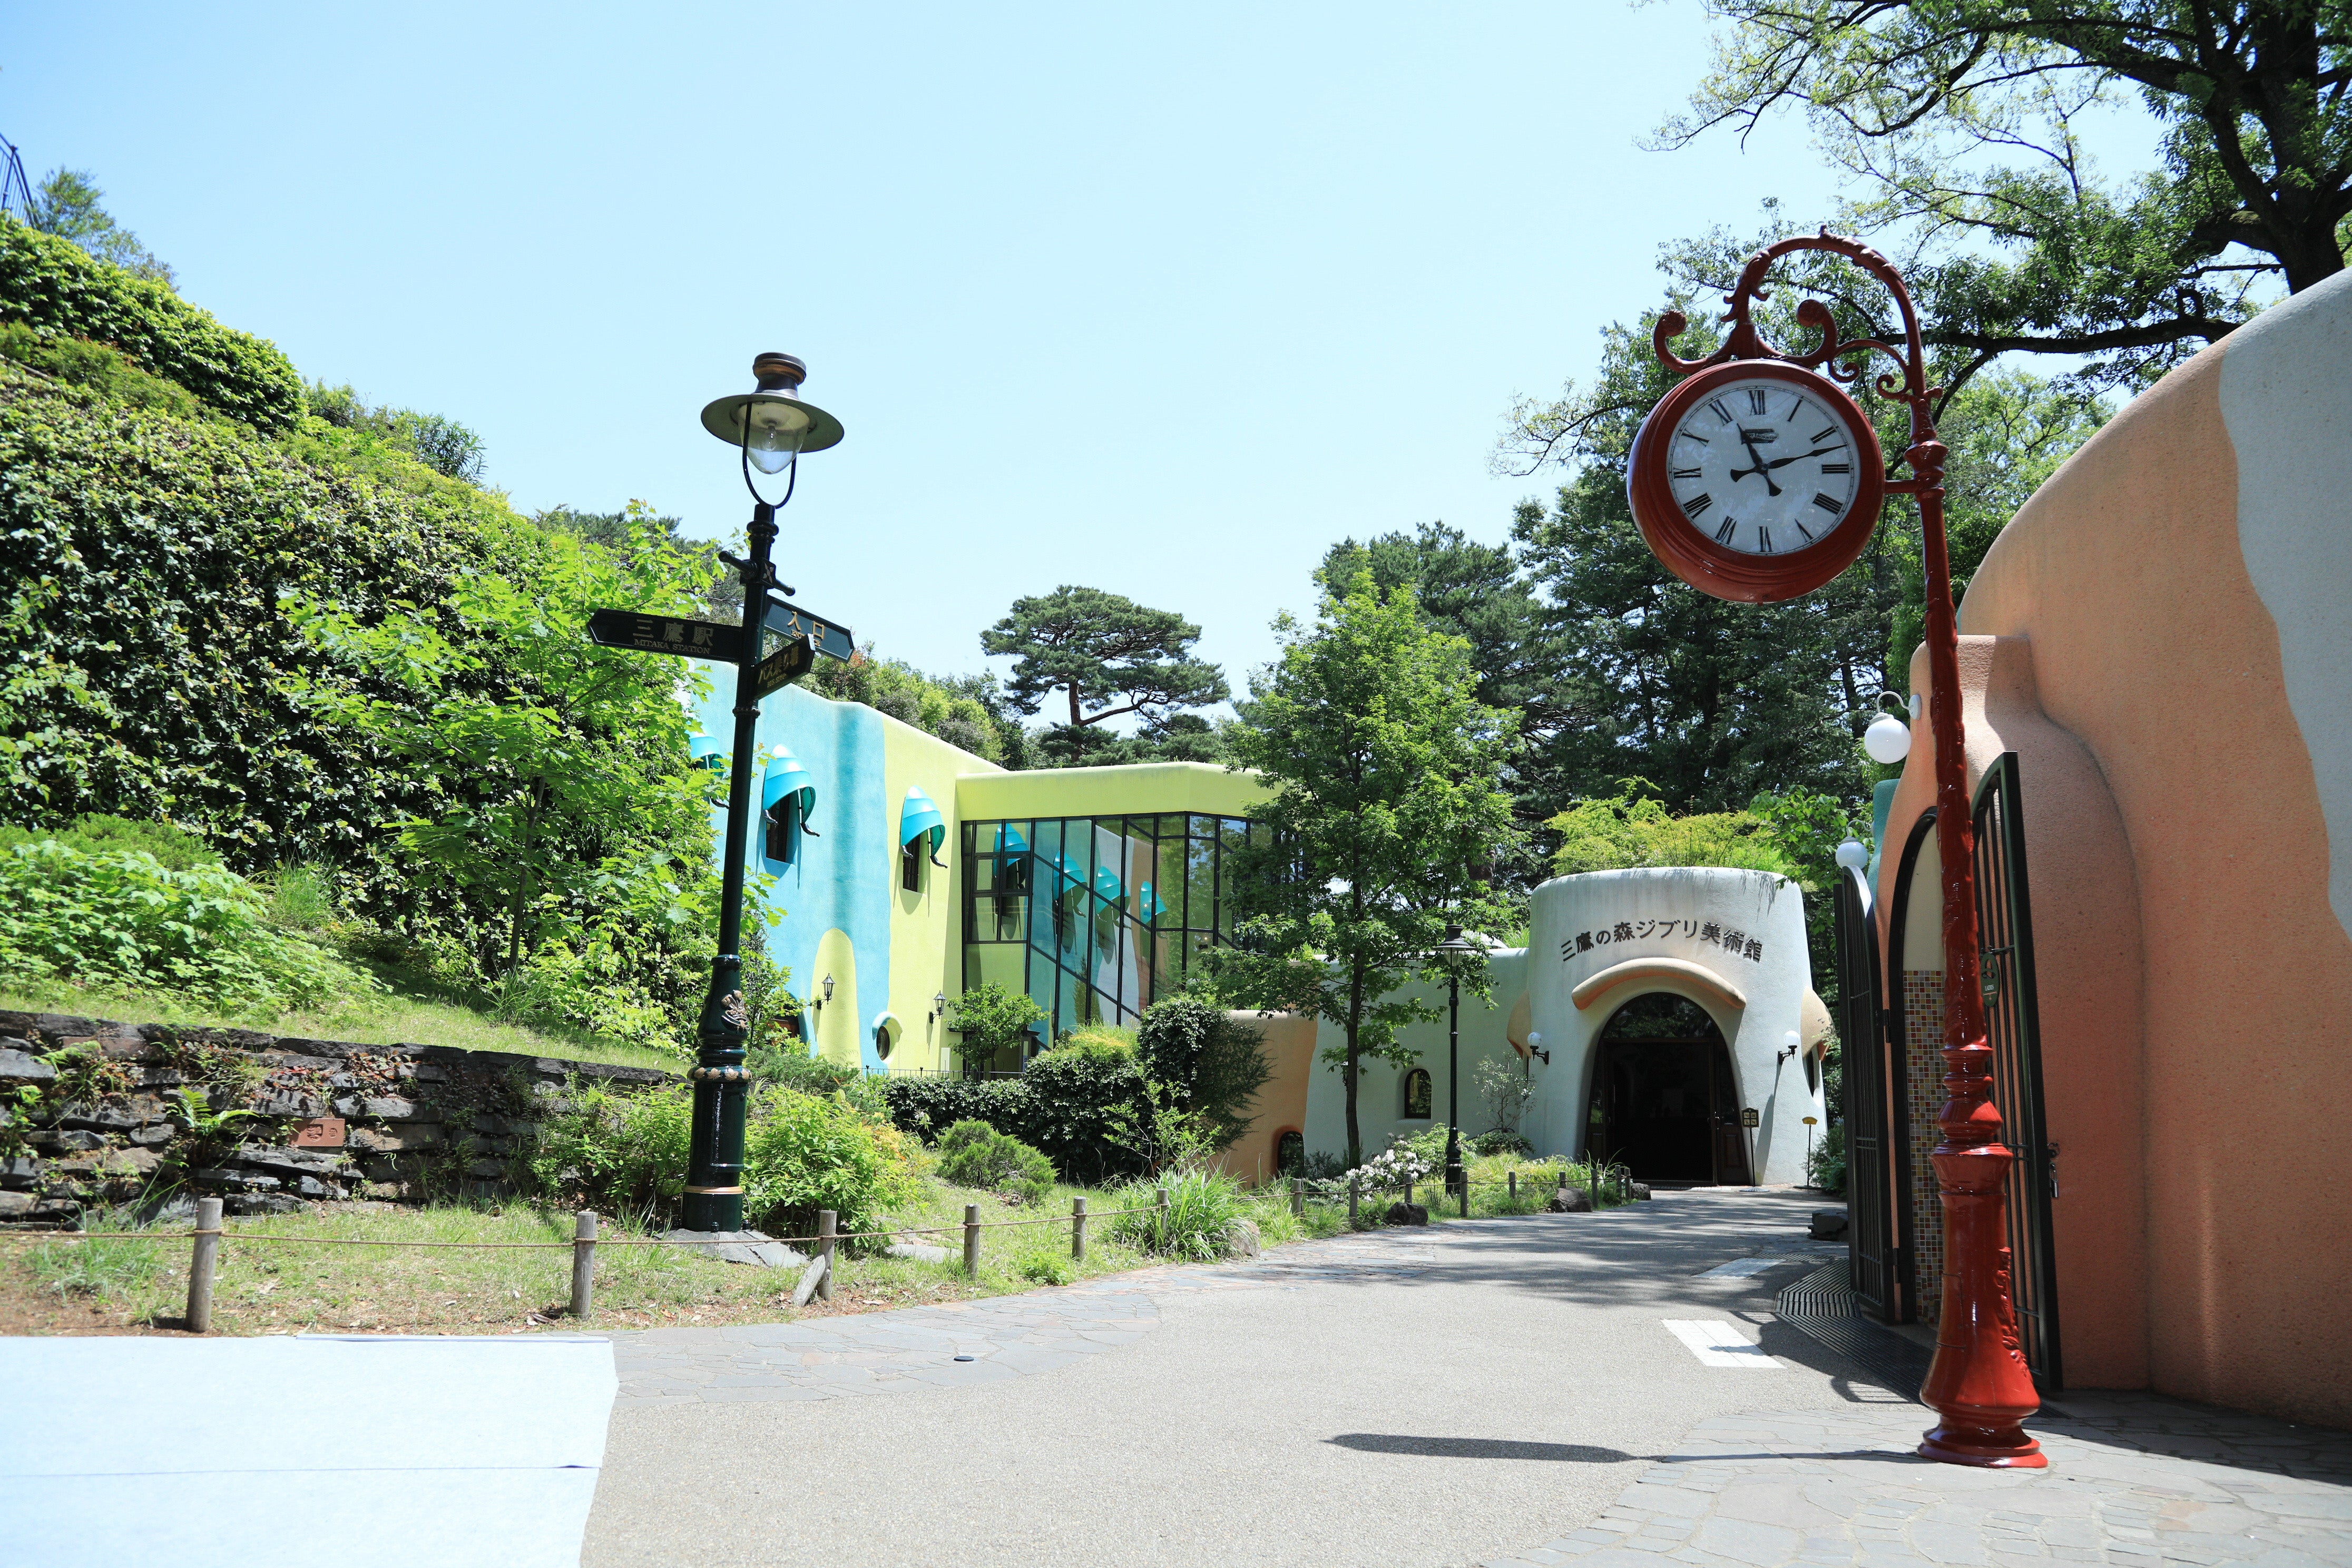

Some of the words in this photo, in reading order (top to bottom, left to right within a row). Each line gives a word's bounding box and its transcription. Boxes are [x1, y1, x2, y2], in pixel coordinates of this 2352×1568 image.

[632, 619, 713, 646] 三鷹駅
[787, 611, 825, 640] 入口
[634, 639, 670, 649] MITAKA
[672, 643, 711, 654] STATION
[1561, 919, 1763, 962] 三鷹の森ジブリ美術館
